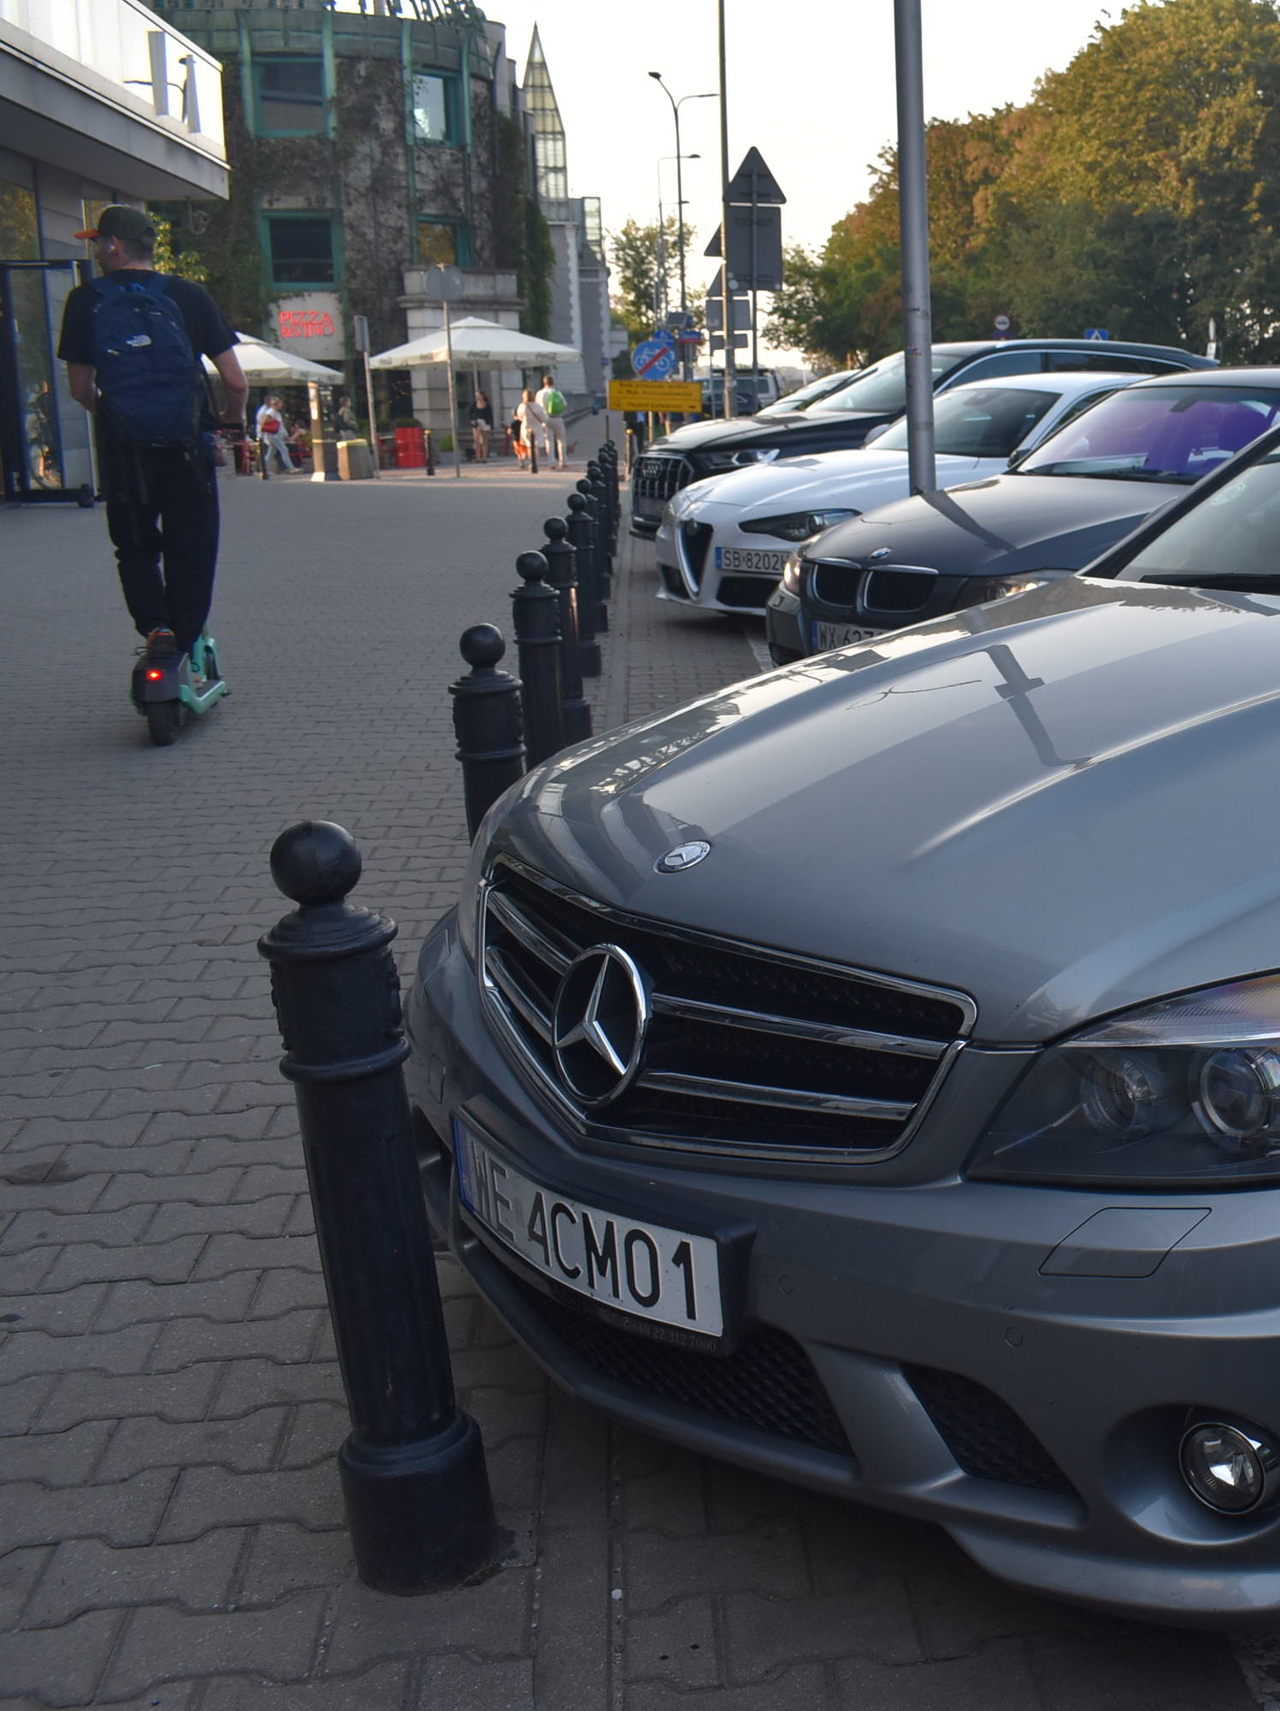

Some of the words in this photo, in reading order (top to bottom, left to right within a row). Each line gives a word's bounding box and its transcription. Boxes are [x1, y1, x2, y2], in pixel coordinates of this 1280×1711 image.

[280, 311, 333, 325] PIZZA
[723, 550, 741, 568] SB
[819, 625, 836, 649] WX
[471, 1140, 516, 1243] WE
[528, 1191, 698, 1321] 4CM01
